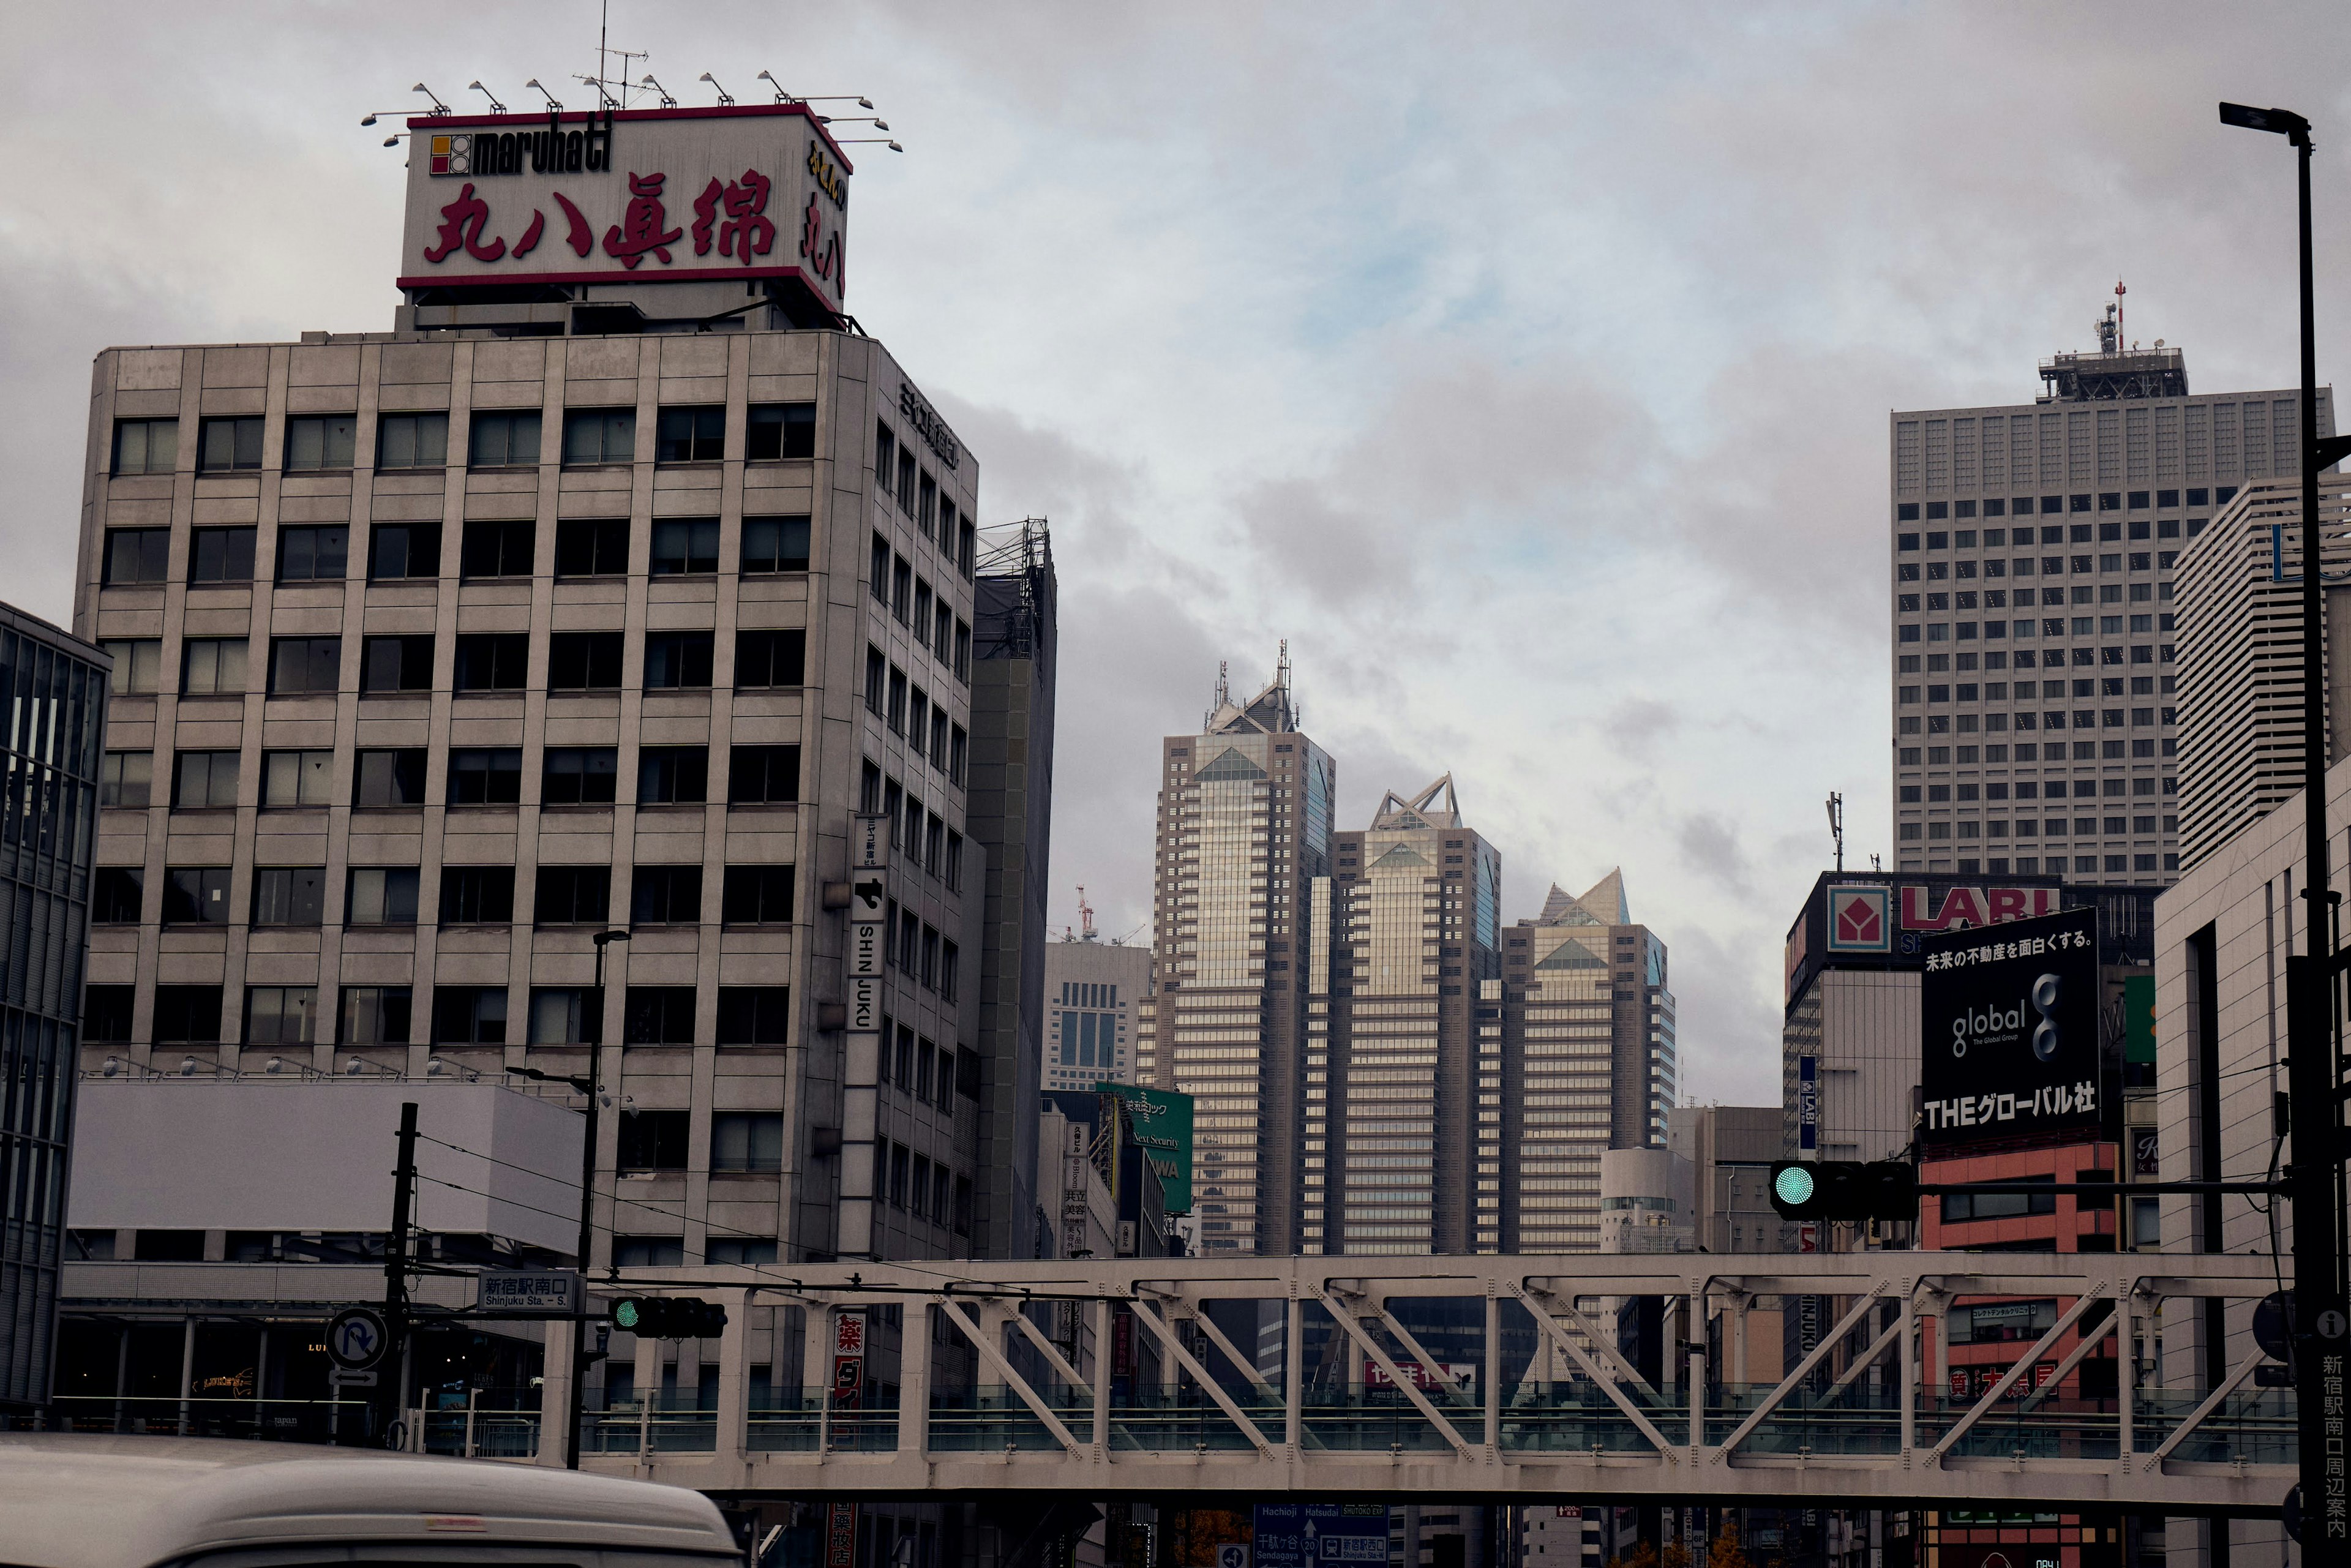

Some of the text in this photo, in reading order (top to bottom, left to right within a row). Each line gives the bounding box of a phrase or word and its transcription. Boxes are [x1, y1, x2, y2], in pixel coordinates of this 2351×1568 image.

[473, 111, 613, 175] maruhati
[1901, 886, 2061, 930] LABI
[1925, 929, 2091, 972] 未来の不動産を面白くする。
[1952, 999, 2025, 1058] global
[2001, 1033, 2019, 1043] Group
[1805, 1095, 1815, 1125] LABI
[1924, 1080, 2096, 1130] THEグローバル社
[1133, 1131, 1180, 1148] Next Security
[1065, 1191, 1085, 1202] 共立
[1065, 1204, 1085, 1215] 美容
[485, 1277, 567, 1295] 新宿駅南口
[486, 1296, 524, 1307] Shinjuku
[527, 1296, 544, 1305] Sta.
[557, 1296, 566, 1306] S.
[1973, 1304, 2036, 1317] コレクトデンタルクリニック
[837, 1315, 863, 1352] 薬
[1951, 1373, 1967, 1396] 質
[2323, 1355, 2346, 1538] 新宿駅南口周辺案内
[1262, 1507, 1339, 1518] Hachioji Hatsudai
[1304, 1541, 1315, 1551] 20
[1343, 1539, 1384, 1551] 新宿駅西口
[1256, 1551, 1299, 1561] Sendagaya
